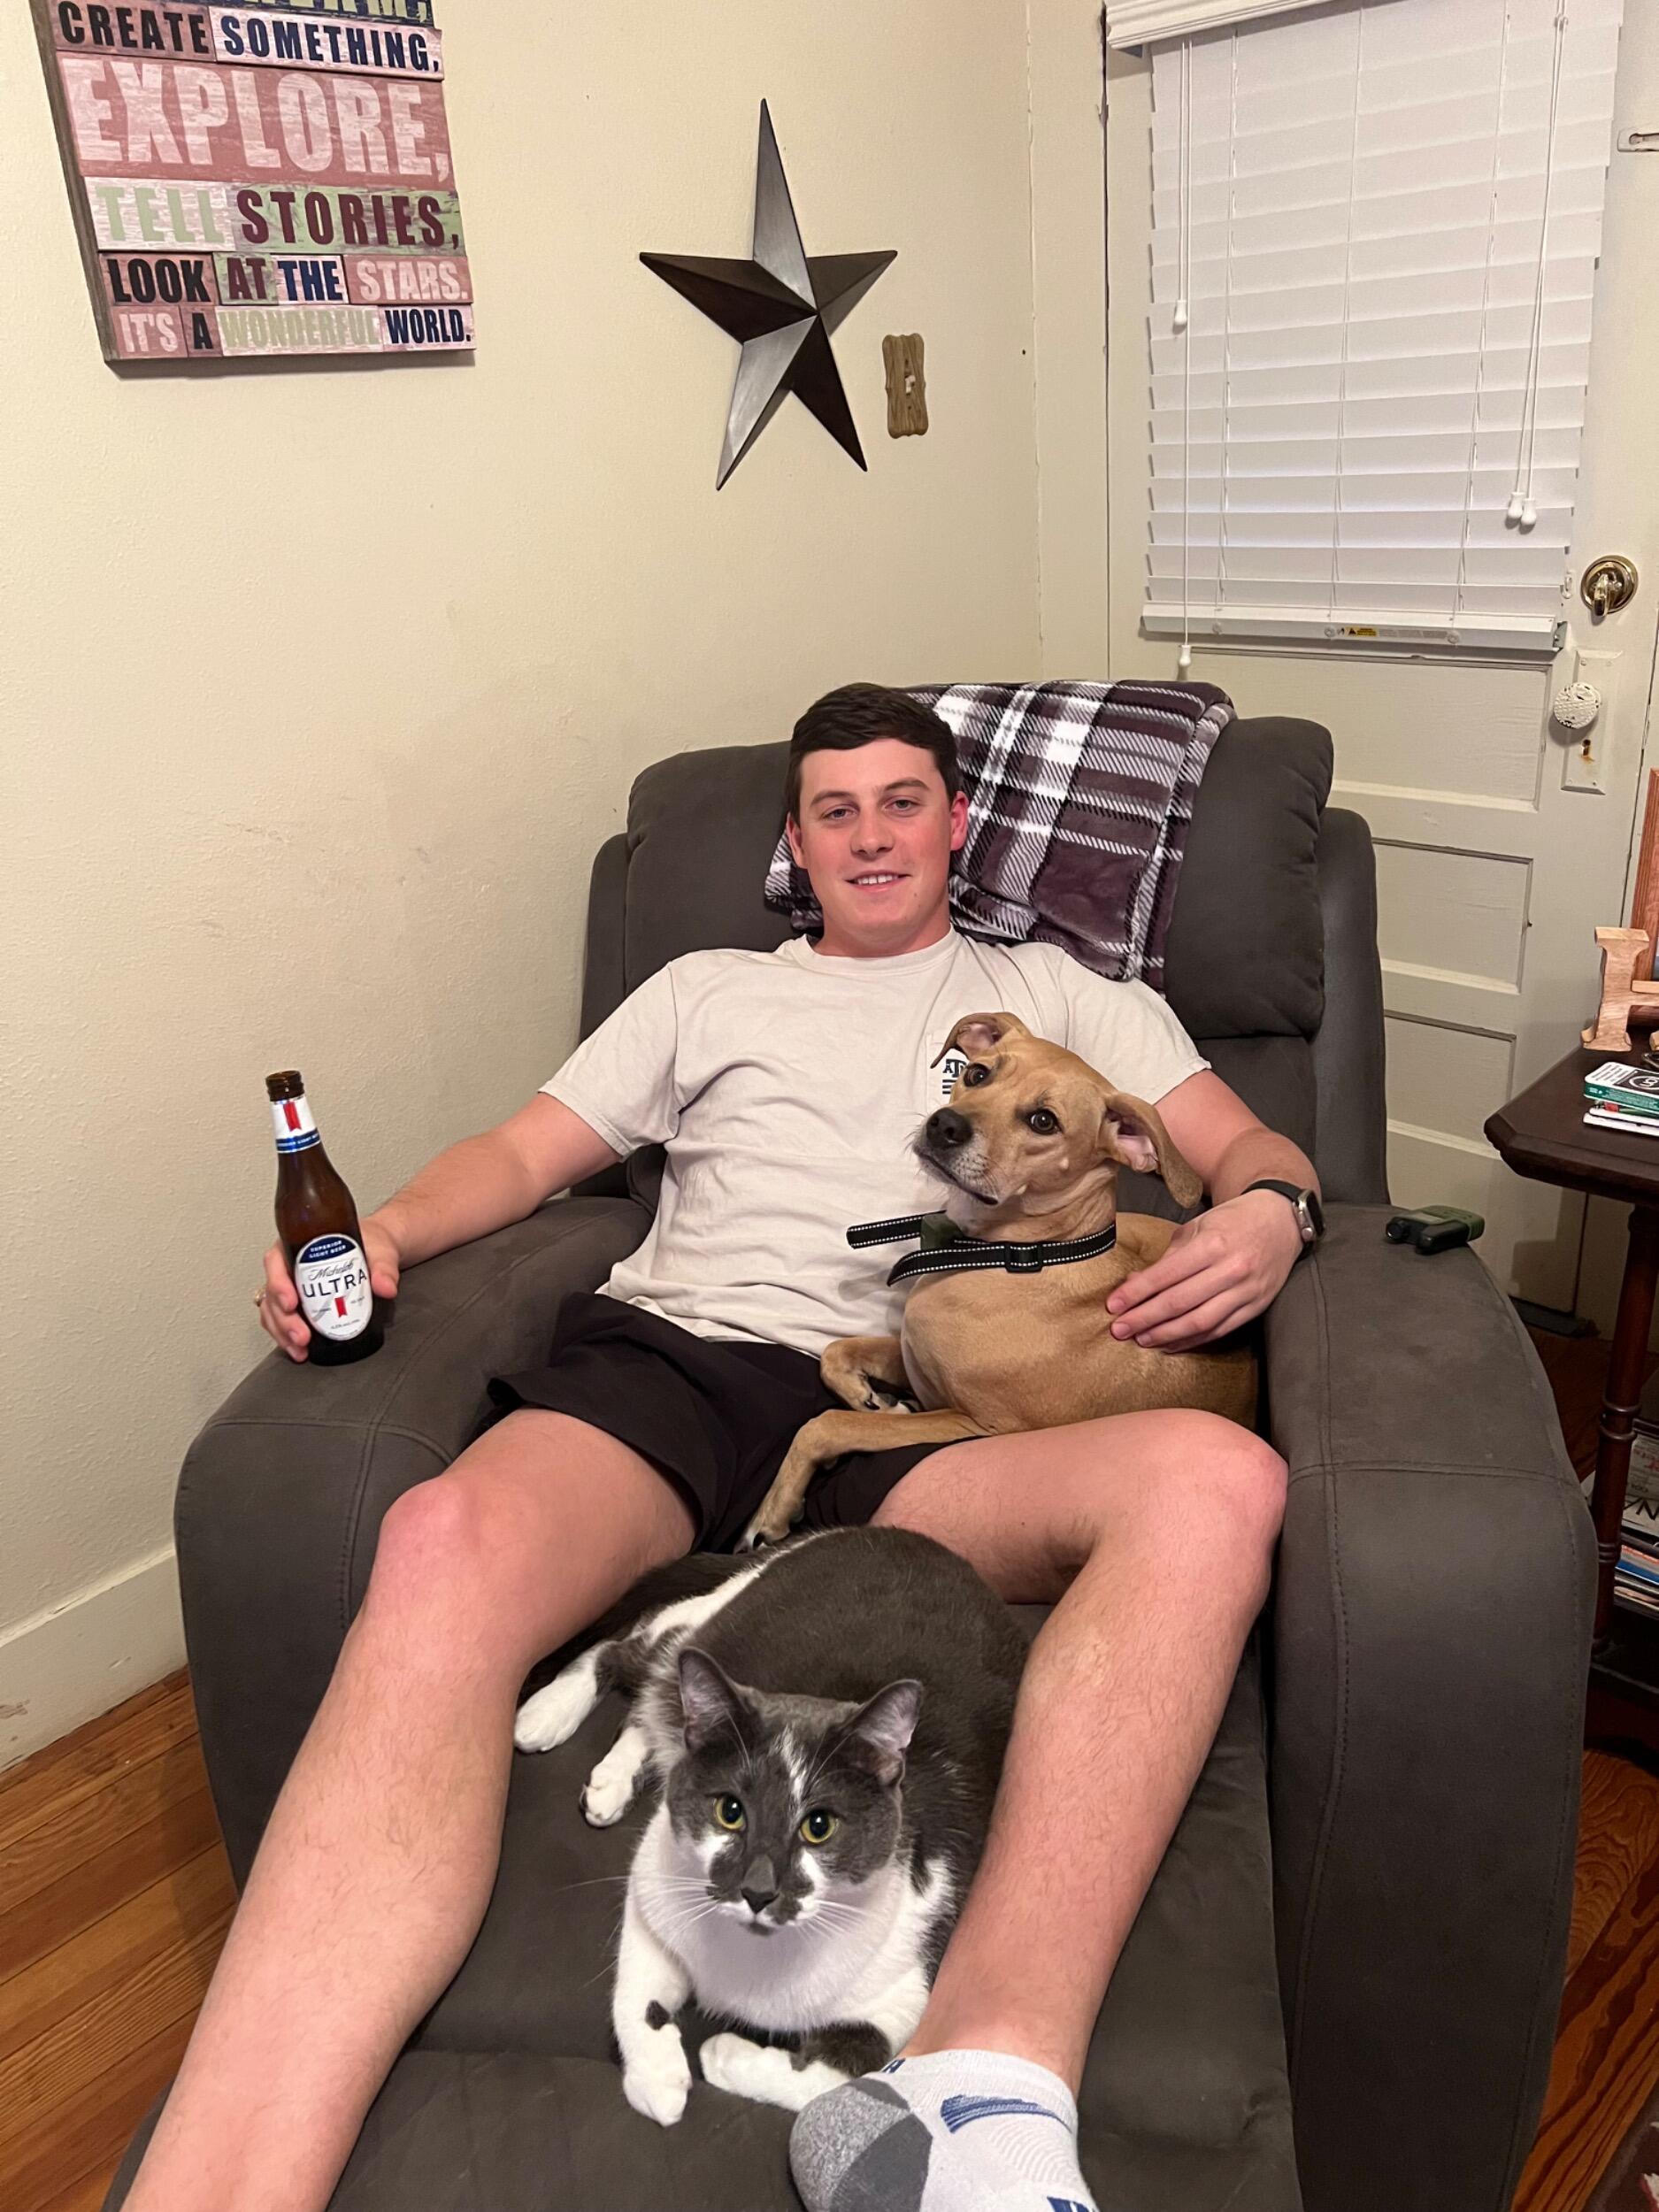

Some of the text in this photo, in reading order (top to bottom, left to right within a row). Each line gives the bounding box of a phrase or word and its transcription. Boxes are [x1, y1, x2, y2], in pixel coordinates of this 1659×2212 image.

[58, 1, 210, 54] CREATE
[220, 15, 441, 73] SOMETHING,
[61, 57, 450, 182] EXPLORE,
[96, 186, 458, 250] TELL STORIES,
[107, 257, 469, 303] LOOK AT THE STARS.
[119, 309, 472, 352] IT'S A WONDERFUL WORLD.
[309, 1250, 329, 1259] LIGHT
[302, 1268, 368, 1298] ULTRA
